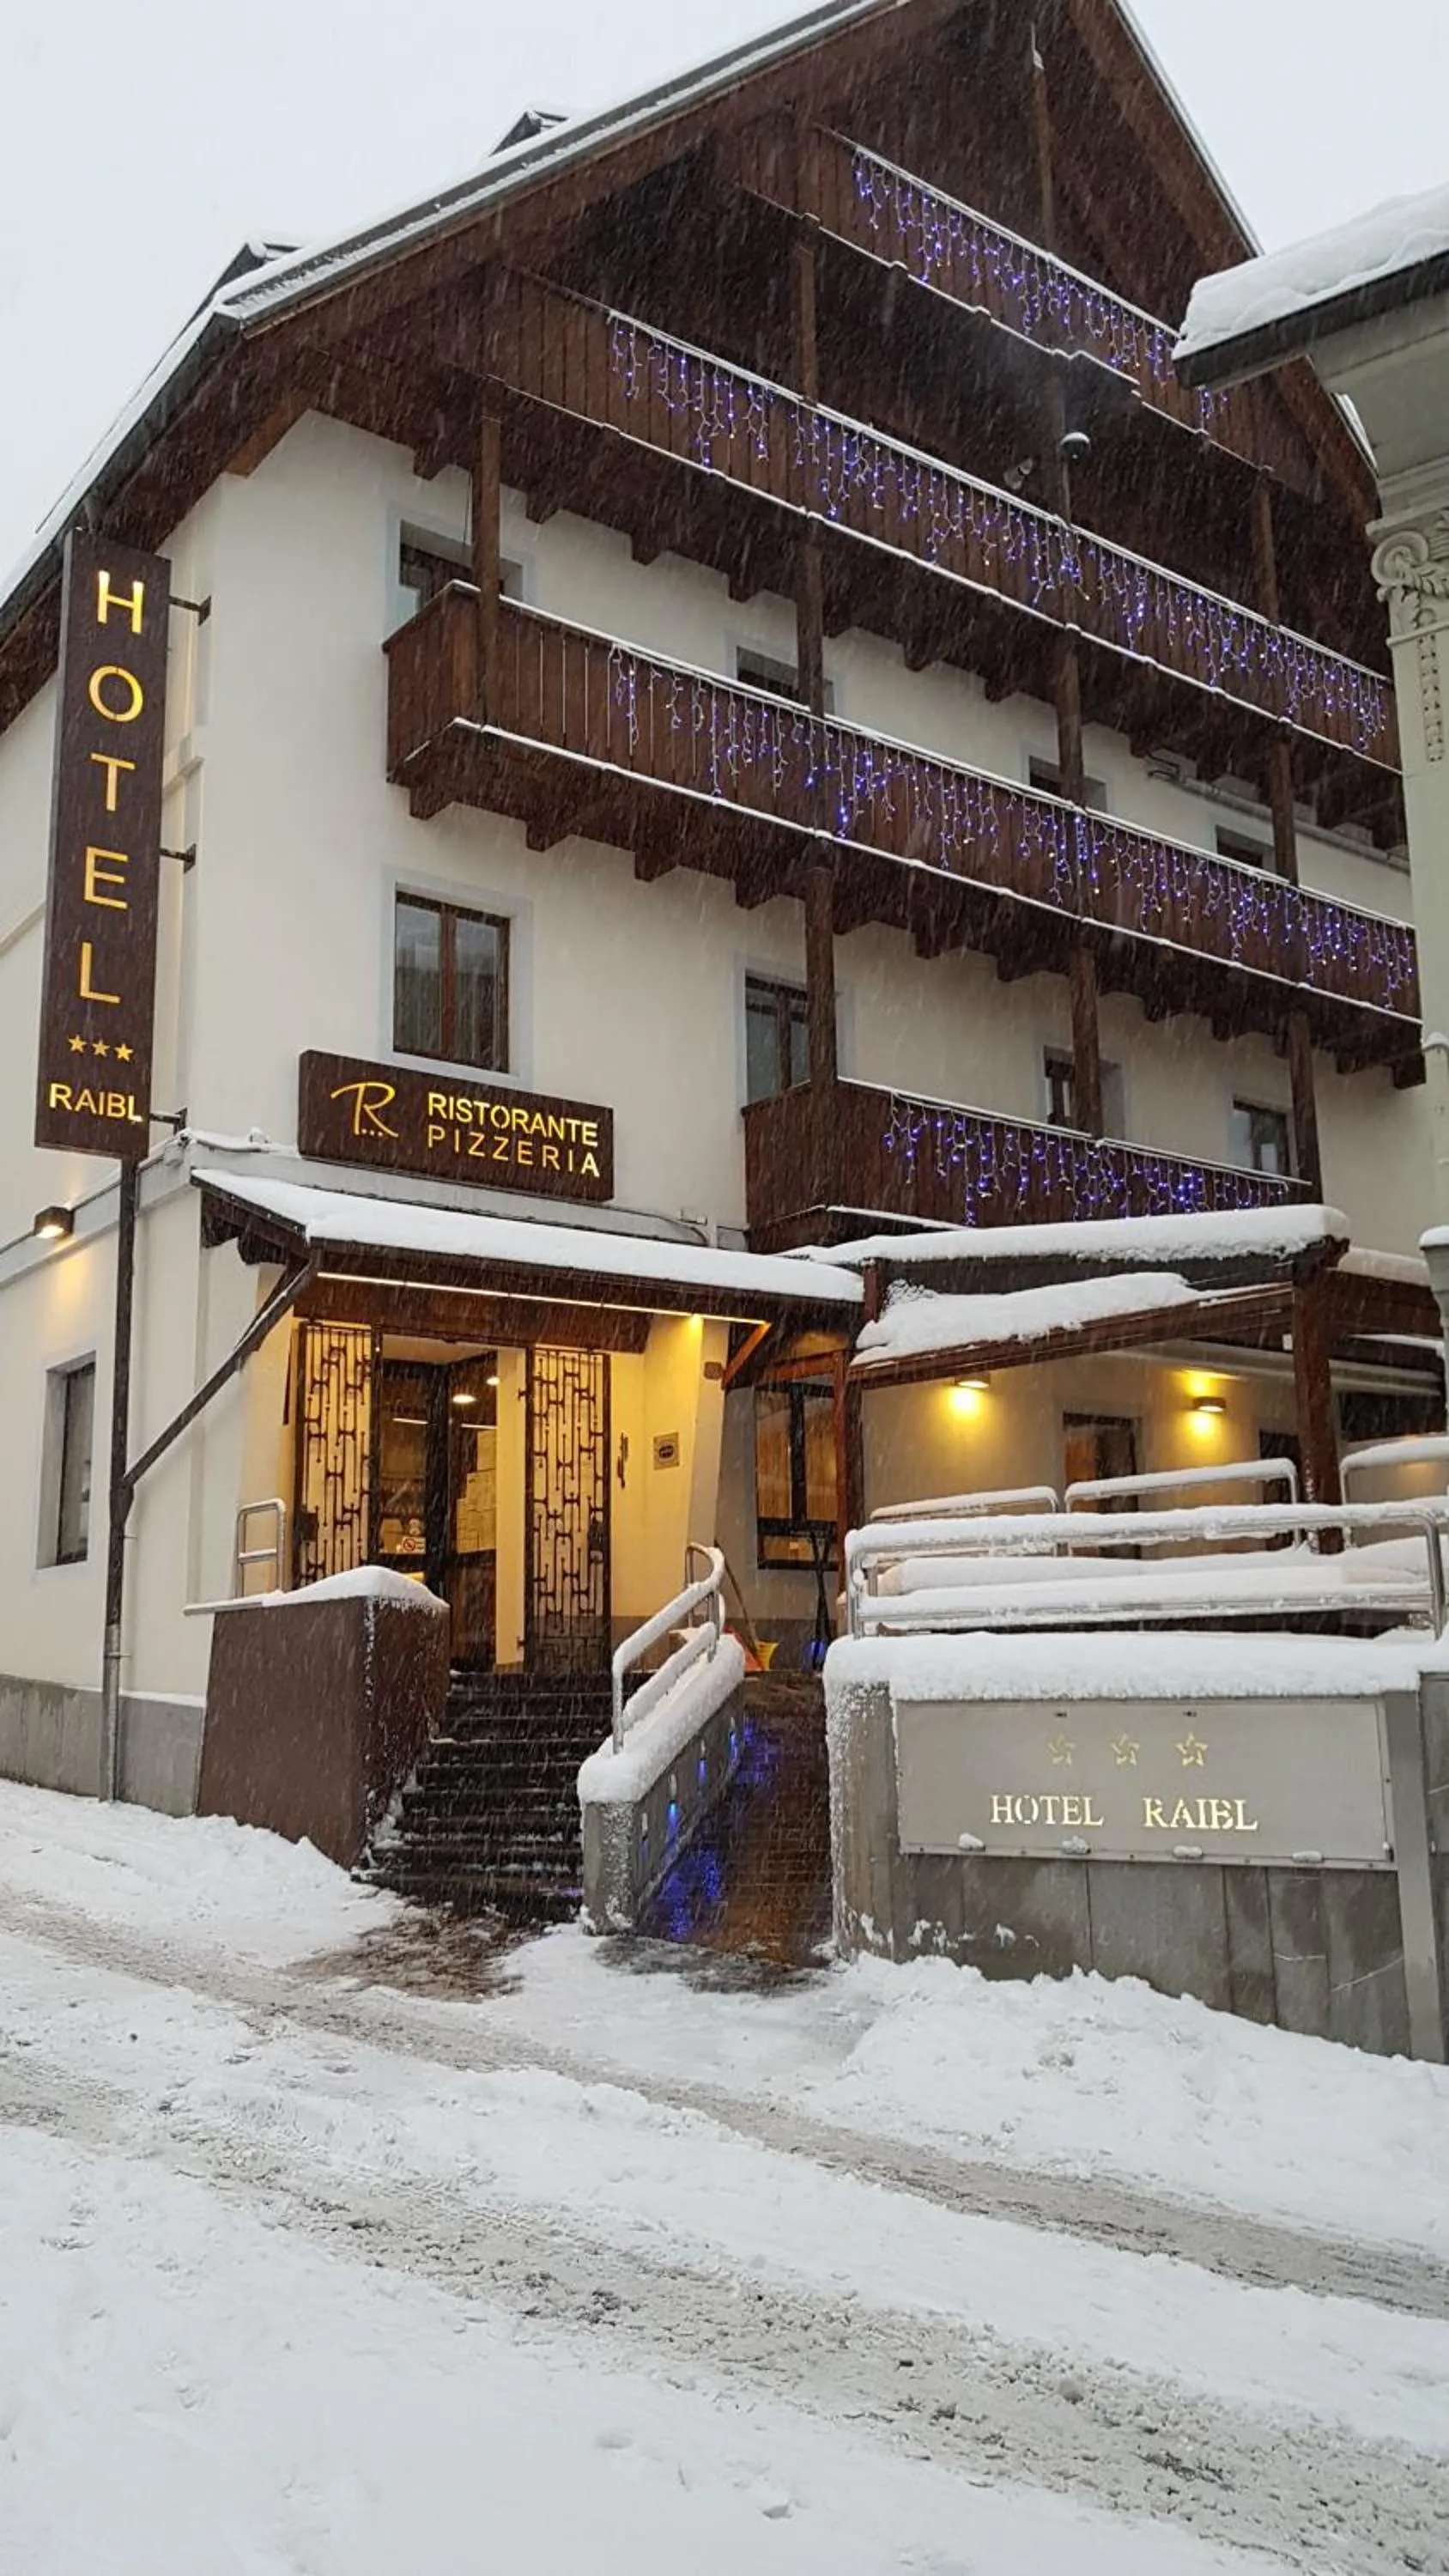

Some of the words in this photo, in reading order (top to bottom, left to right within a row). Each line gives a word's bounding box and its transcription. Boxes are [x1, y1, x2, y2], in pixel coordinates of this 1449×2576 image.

[78, 569, 146, 1005] HOTEL
[47, 1082, 143, 1124] RAIBL
[427, 1092, 599, 1148] RISTORANTE
[427, 1123, 600, 1178] PIZZERIA
[989, 1794, 1105, 1827] HOTEL
[1142, 1796, 1259, 1832] RAIBL
